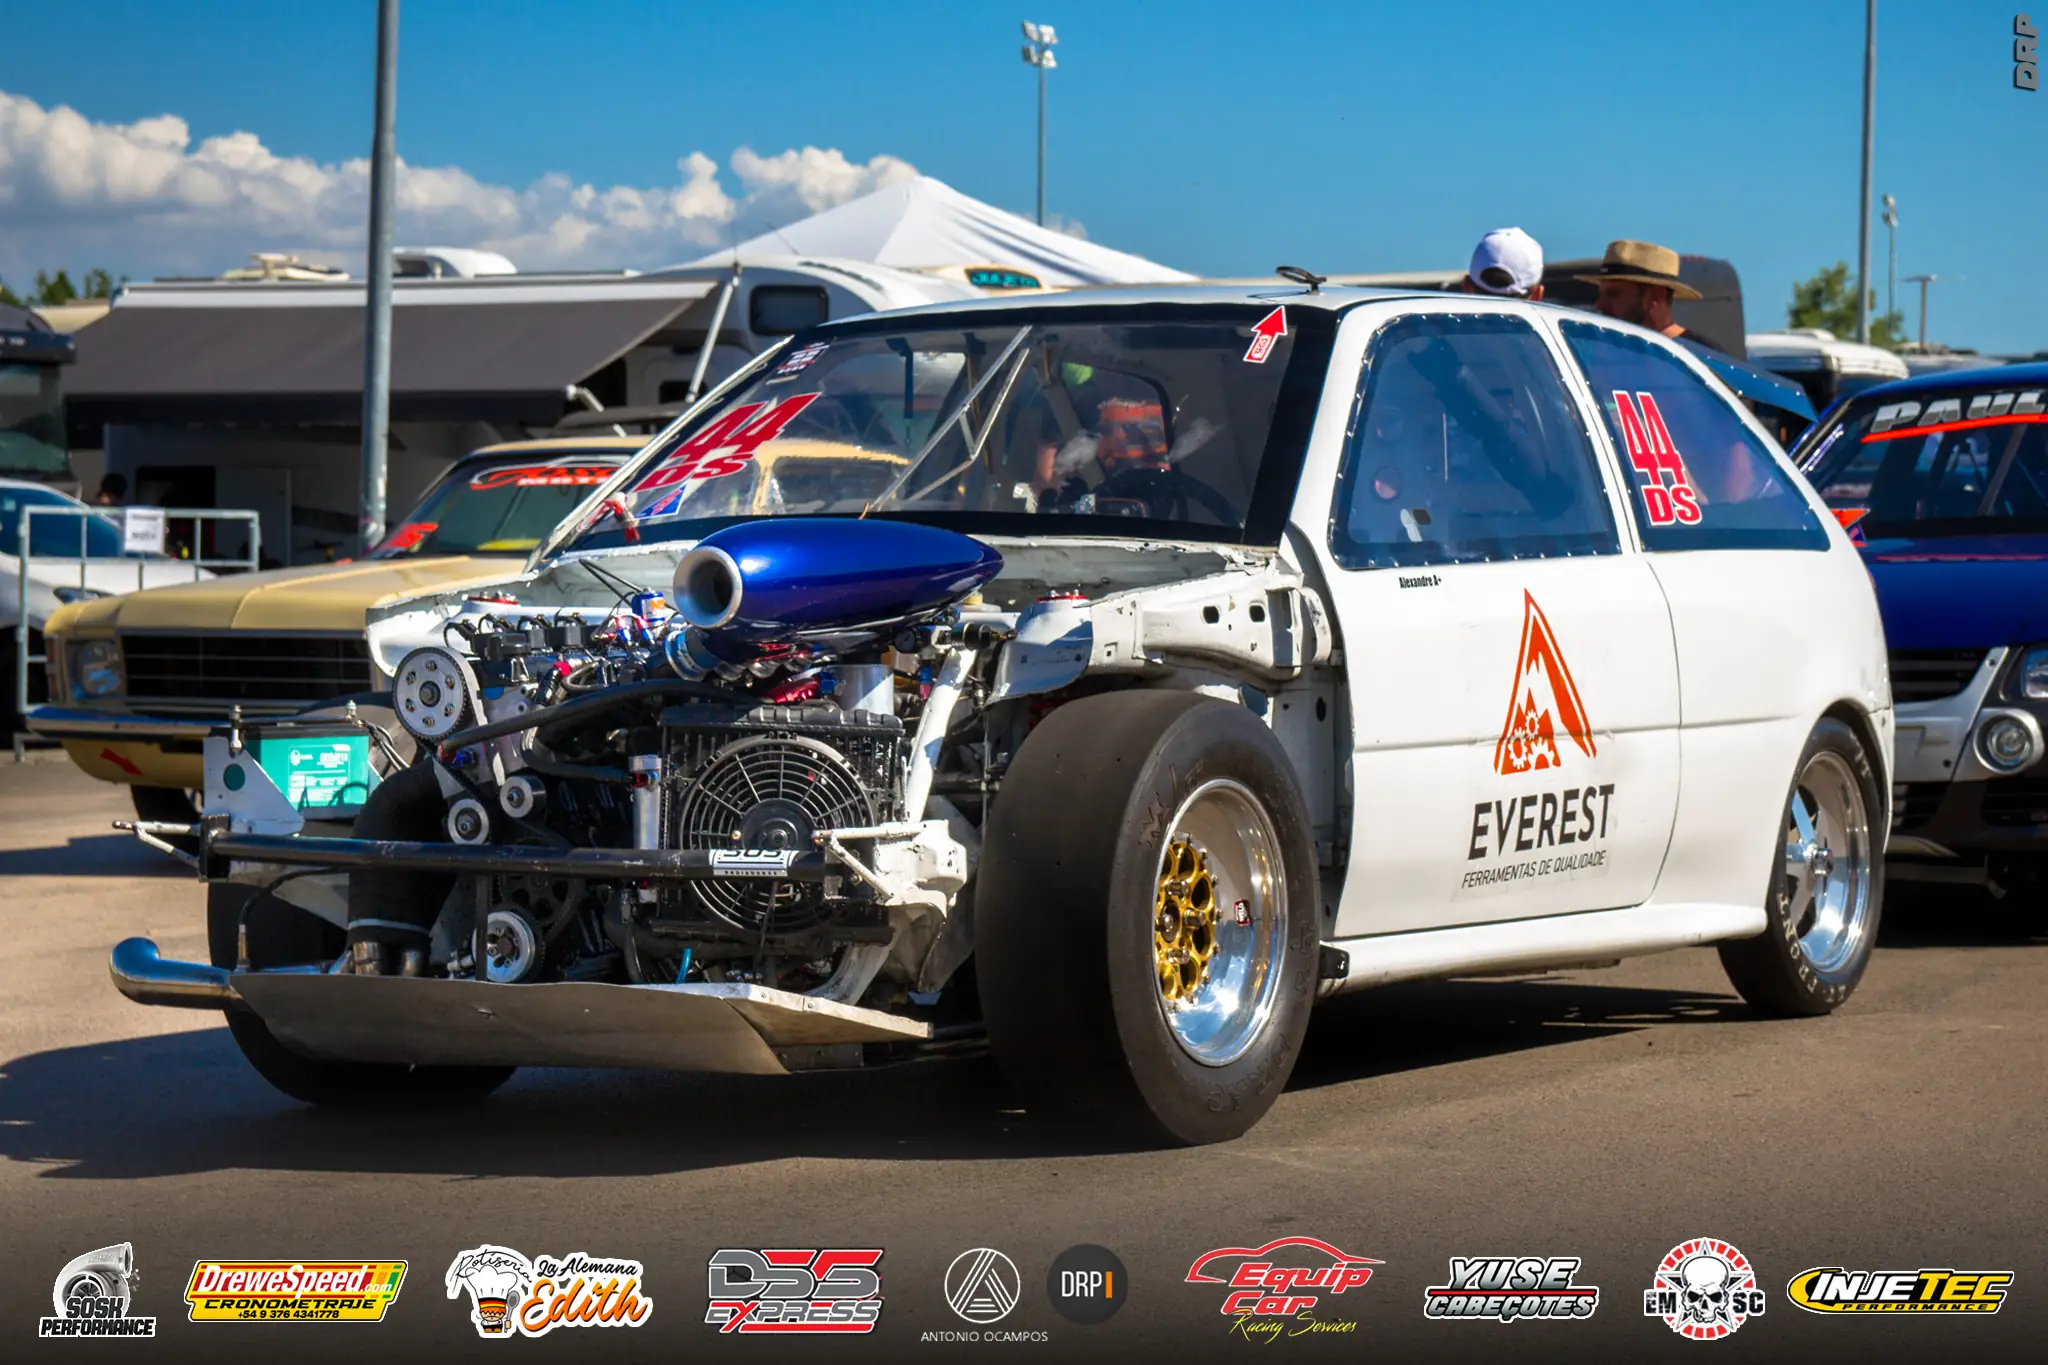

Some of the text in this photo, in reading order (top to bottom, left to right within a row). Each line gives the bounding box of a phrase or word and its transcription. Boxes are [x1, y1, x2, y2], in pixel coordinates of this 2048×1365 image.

[667, 391, 823, 463] 44
[1612, 390, 1688, 486] 44
[633, 452, 755, 493] DS
[1641, 485, 1703, 526] DS
[1399, 575, 1433, 588] Alexandre
[1467, 783, 1615, 861] EVEREST
[1461, 849, 1607, 889] FERRAMENTAS DE QUALIDADE
